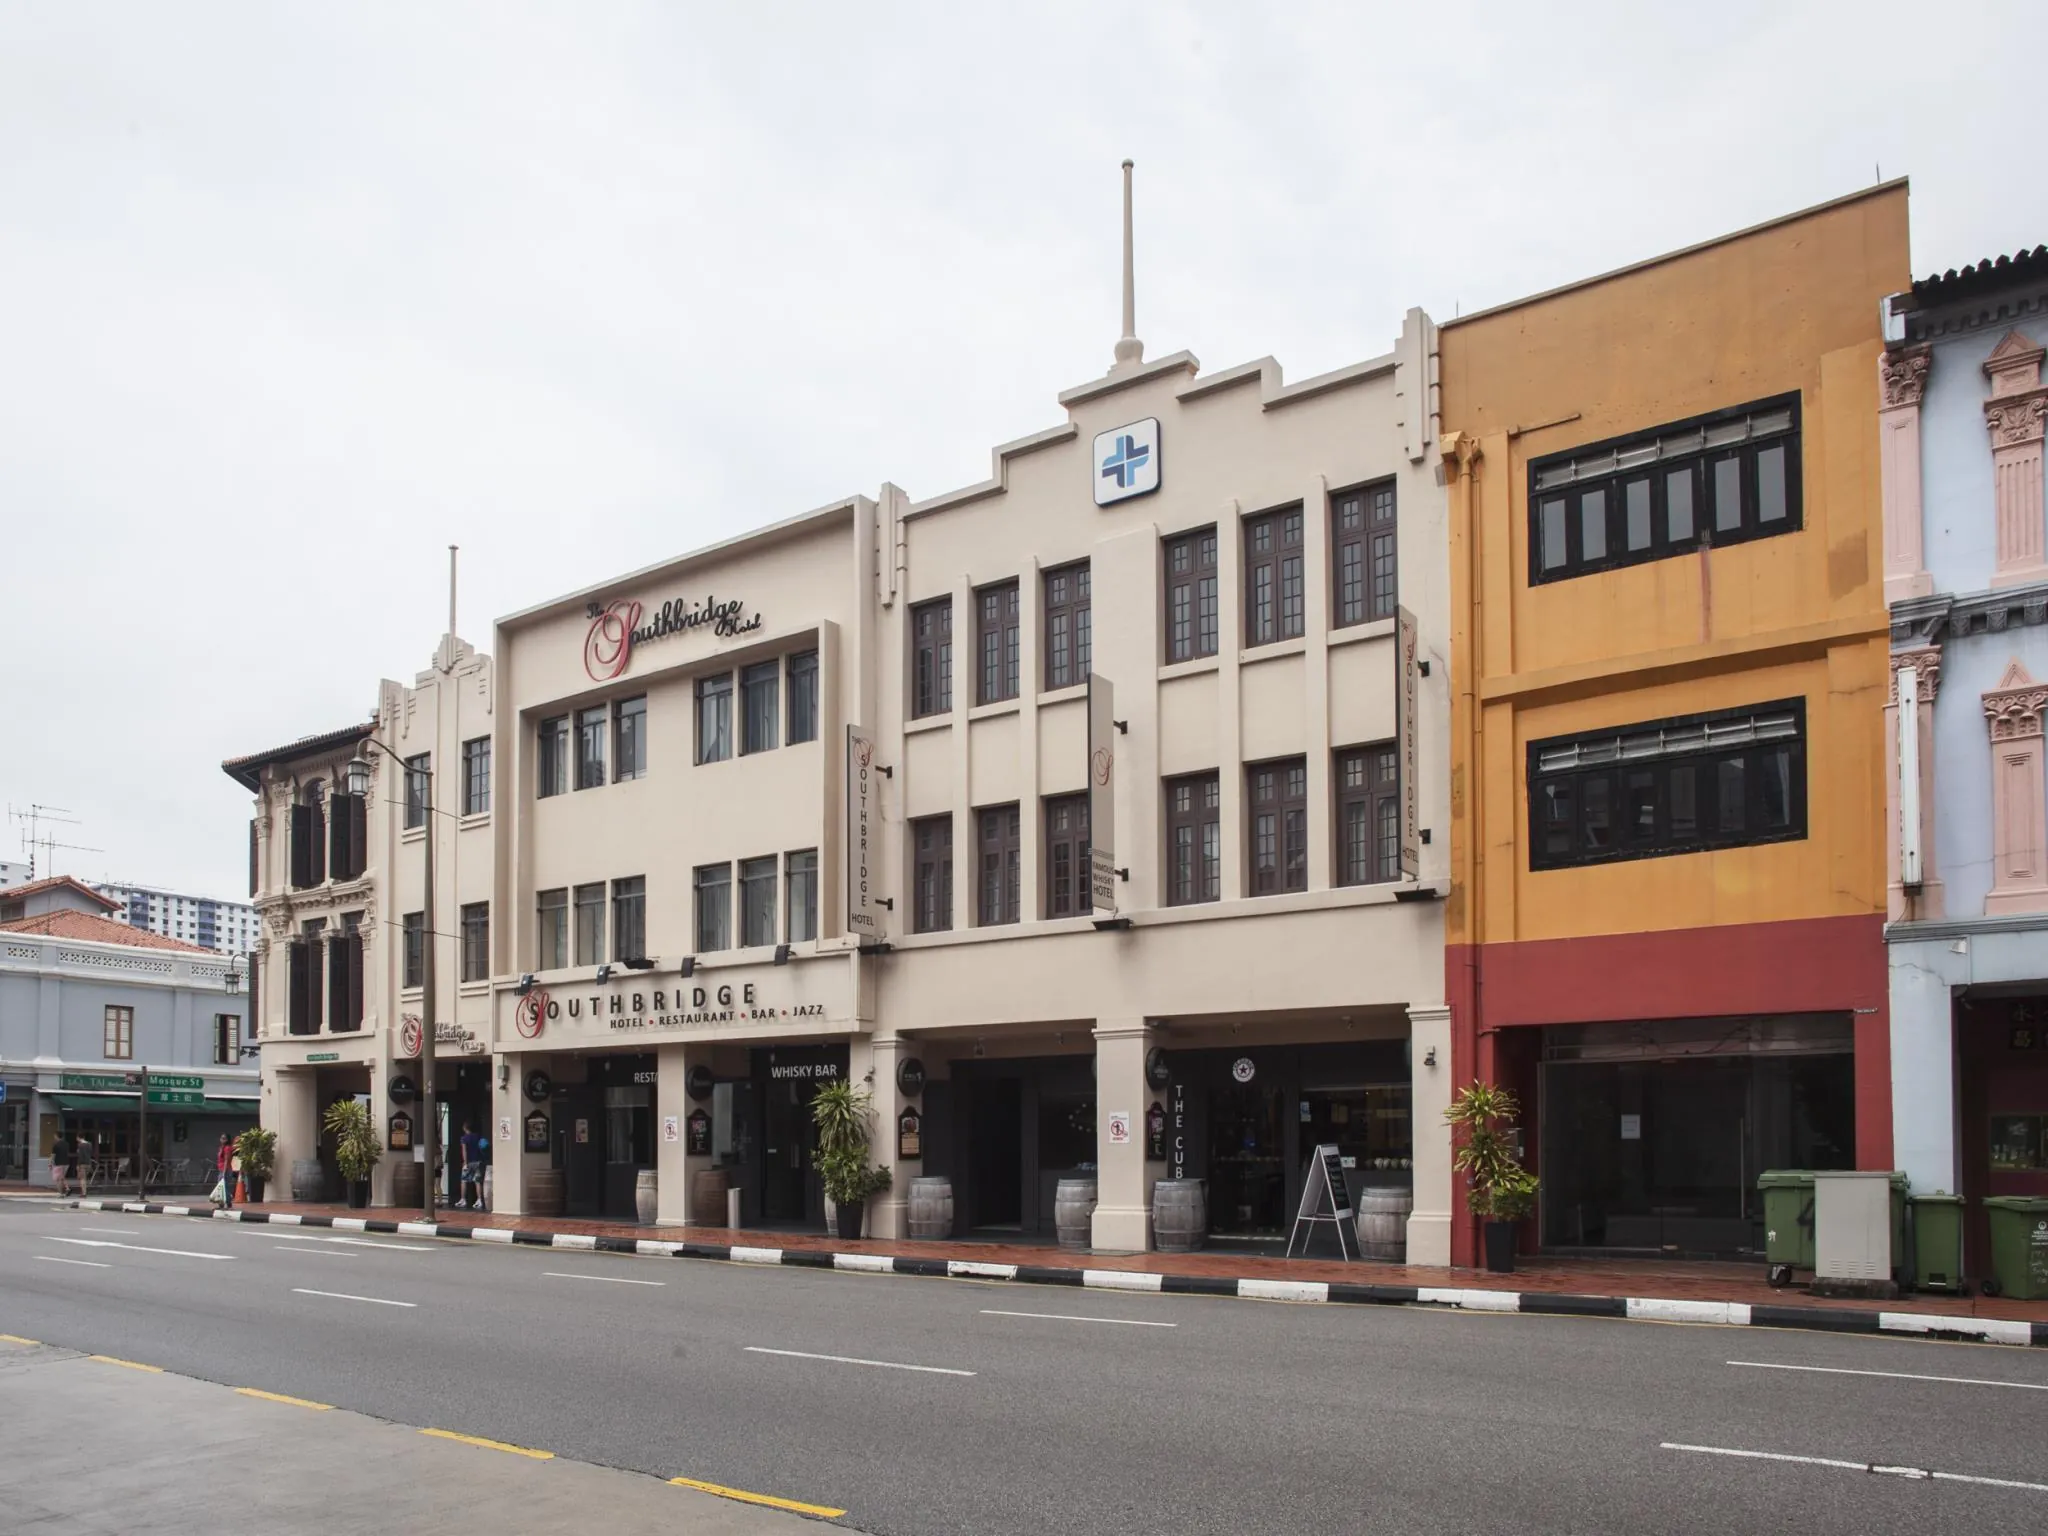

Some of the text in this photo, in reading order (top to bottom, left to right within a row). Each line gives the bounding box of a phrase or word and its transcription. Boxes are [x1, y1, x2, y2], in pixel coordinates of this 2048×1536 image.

[586, 603, 605, 619] The
[725, 613, 762, 637] Hotel
[584, 595, 743, 682] Southbridge
[1402, 848, 1419, 865] HOTEL
[1092, 861, 1114, 875] FAMOUS
[1093, 873, 1114, 886] WHISKY
[1093, 886, 1114, 900] HOTEL
[851, 913, 874, 927] HOTEL
[529, 983, 755, 1021] SOUTHBRIDGE
[610, 1004, 823, 1029] HOTEL RESTAURANT BAR JAZZ
[771, 1065, 837, 1079] WHISKY BAR
[149, 1076, 200, 1088] Mosque St
[1175, 1085, 1184, 1128] THE
